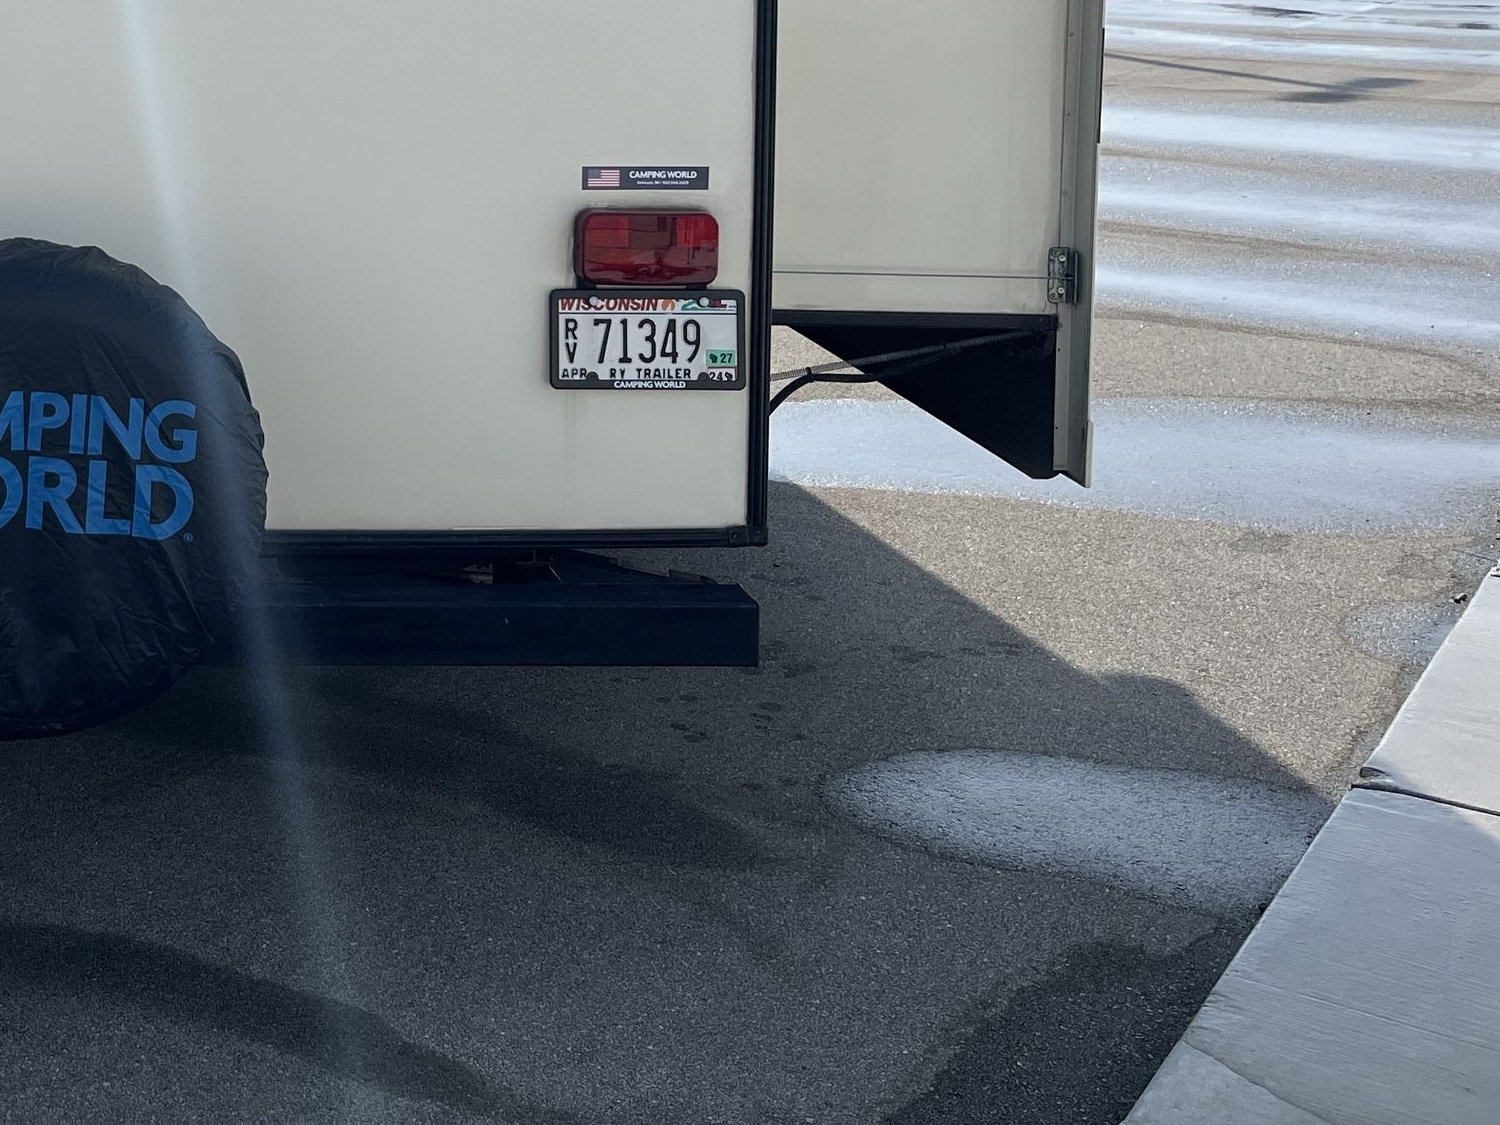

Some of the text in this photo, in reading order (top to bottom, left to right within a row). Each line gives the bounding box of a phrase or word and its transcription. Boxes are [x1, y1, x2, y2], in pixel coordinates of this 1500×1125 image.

[629, 170, 697, 179] CAMPING WORLD
[560, 298, 658, 311] WISCONSIN
[593, 318, 701, 364] 71349
[720, 353, 733, 364] 27
[561, 368, 692, 379] APR RV TRAILER
[709, 371, 724, 381] 24
[614, 380, 686, 389] CAMPING WORLD
